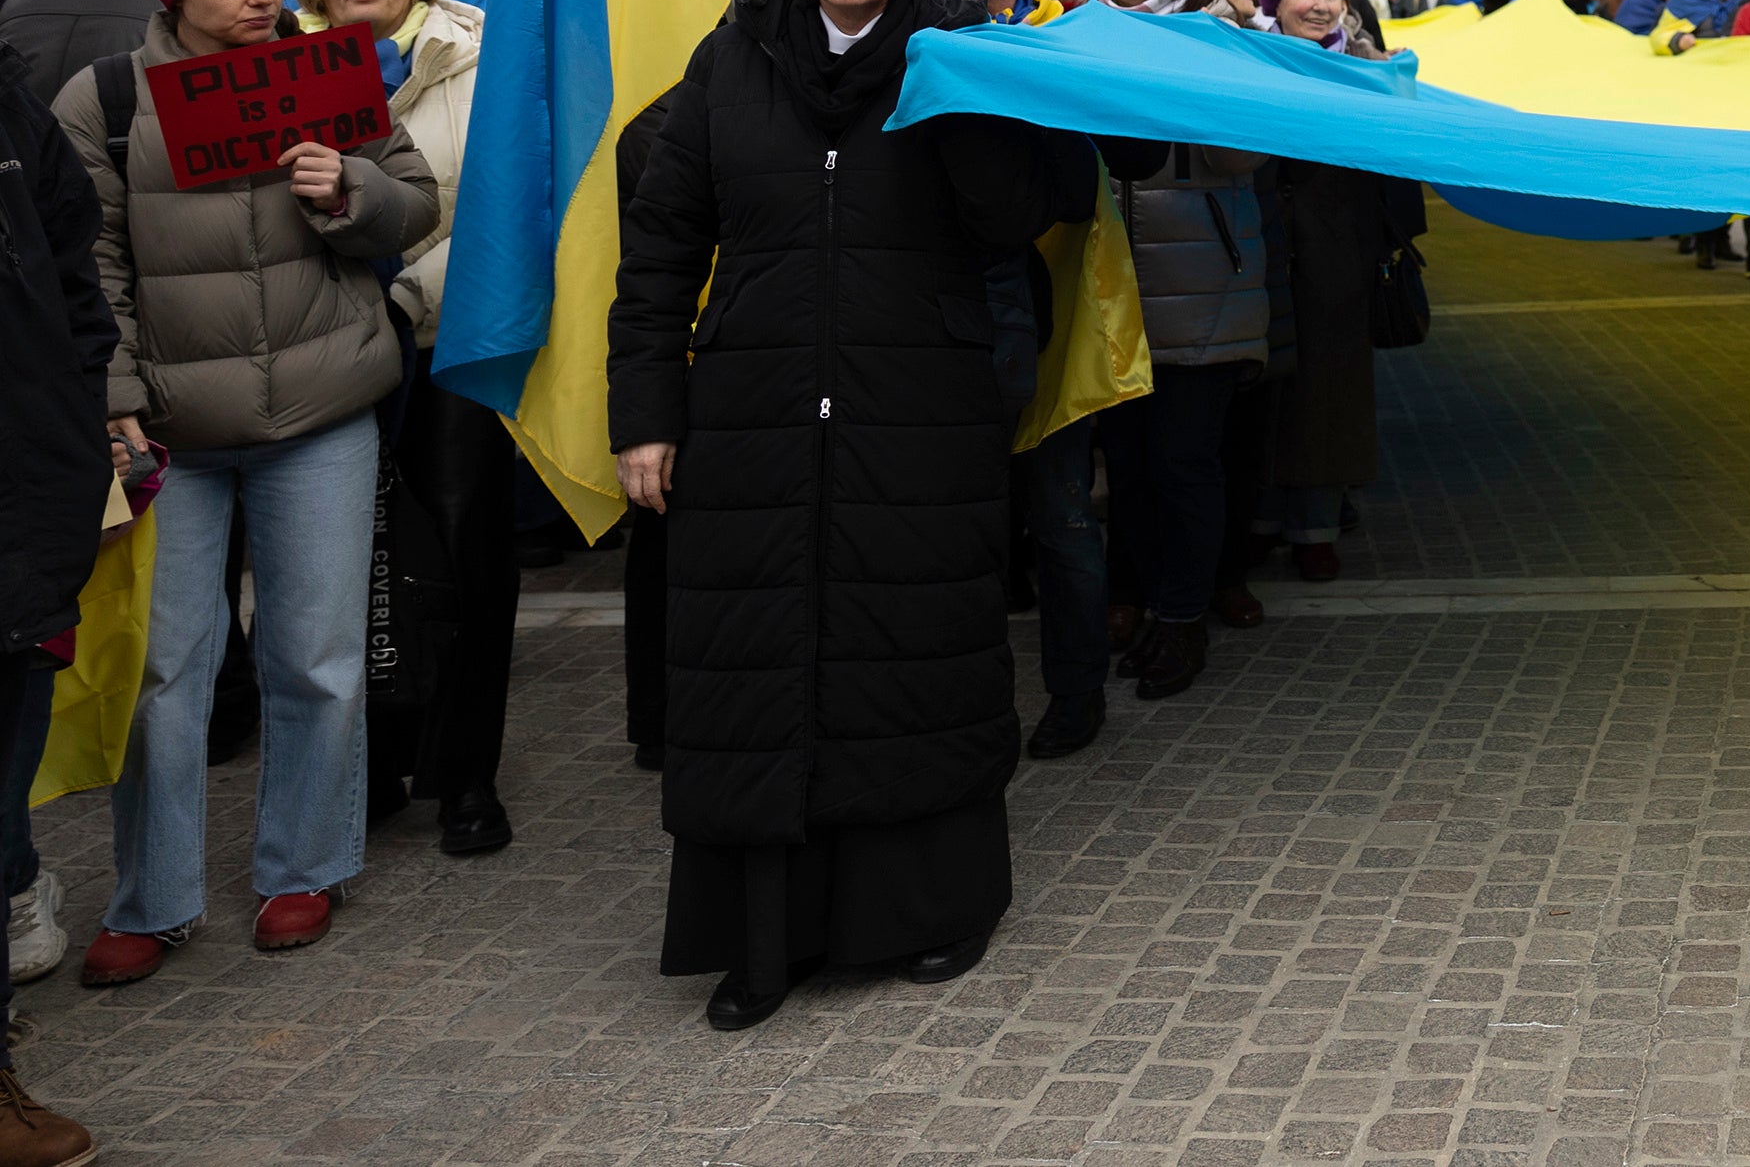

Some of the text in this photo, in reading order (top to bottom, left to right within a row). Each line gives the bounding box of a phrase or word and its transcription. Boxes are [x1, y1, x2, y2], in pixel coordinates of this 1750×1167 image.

[180, 37, 363, 102] PUTIN
[184, 106, 379, 177] DICTATOR
[237, 96, 296, 123] is a
[372, 550, 390, 627] COVERI
